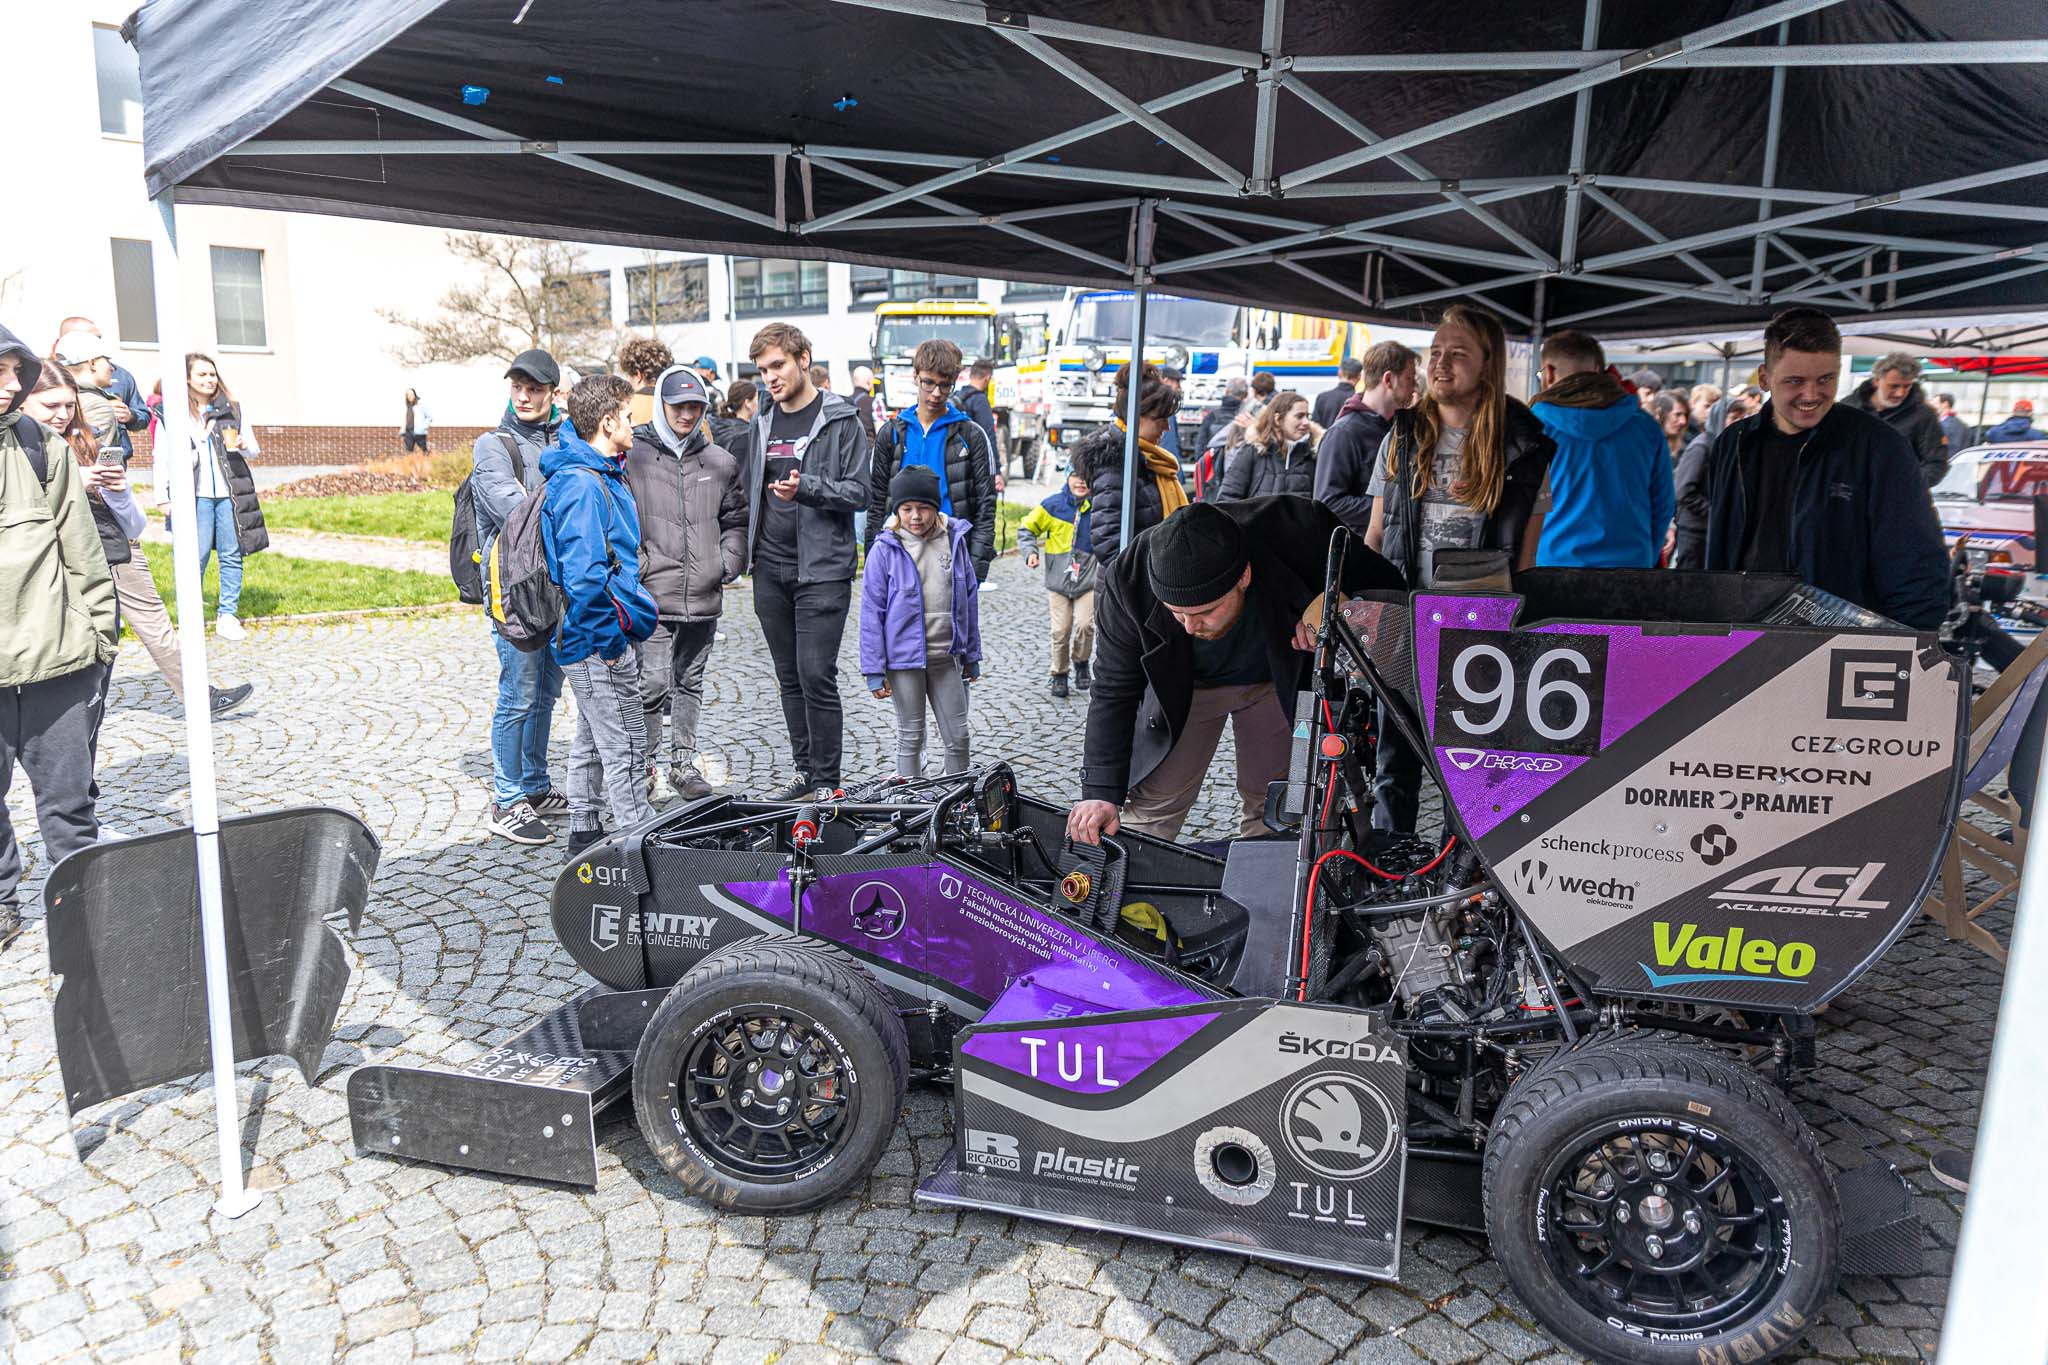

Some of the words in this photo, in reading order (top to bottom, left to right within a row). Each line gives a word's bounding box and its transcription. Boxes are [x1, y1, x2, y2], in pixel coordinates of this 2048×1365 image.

[1451, 644, 1592, 741] 96
[1791, 735, 1838, 754] CEZ
[1845, 737, 1941, 758] GROUP
[1669, 761, 1872, 787] HABERKORN
[1625, 787, 1715, 809] DORMER
[1741, 792, 1834, 815] PRAMET
[1586, 897, 1635, 910] elektroeroze
[1716, 903, 1871, 919] ACLMODEL.CZ
[628, 912, 719, 938] ENTRY
[959, 907, 965, 915] a
[965, 910, 1027, 948] mezioborových
[1027, 941, 1053, 961] studií
[962, 896, 992, 917] Fakulta
[992, 912, 1049, 948] mechatroniky,
[1050, 941, 1099, 973] informatiky
[967, 884, 1017, 920] TECHNICKÁ
[1019, 911, 1073, 946] UNIVERZITA
[1075, 939, 1083, 949] V
[1082, 944, 1119, 970] LIBERCI
[626, 933, 711, 951] ENGINEERING
[1653, 921, 1817, 977] Valeo
[814, 1022, 845, 1054] RACING
[1279, 1031, 1403, 1066] ŠKODA
[1020, 1037, 1120, 1087] TUL
[1618, 1117, 1672, 1129] RACING
[684, 1136, 715, 1168] RACING
[967, 1152, 1018, 1169] RICARDO
[1032, 1147, 1140, 1183] plastic
[1066, 1175, 1099, 1186] composite
[1100, 1179, 1137, 1192] technology
[1288, 1181, 1367, 1221] TUL
[1650, 1331, 1704, 1344] RACING
